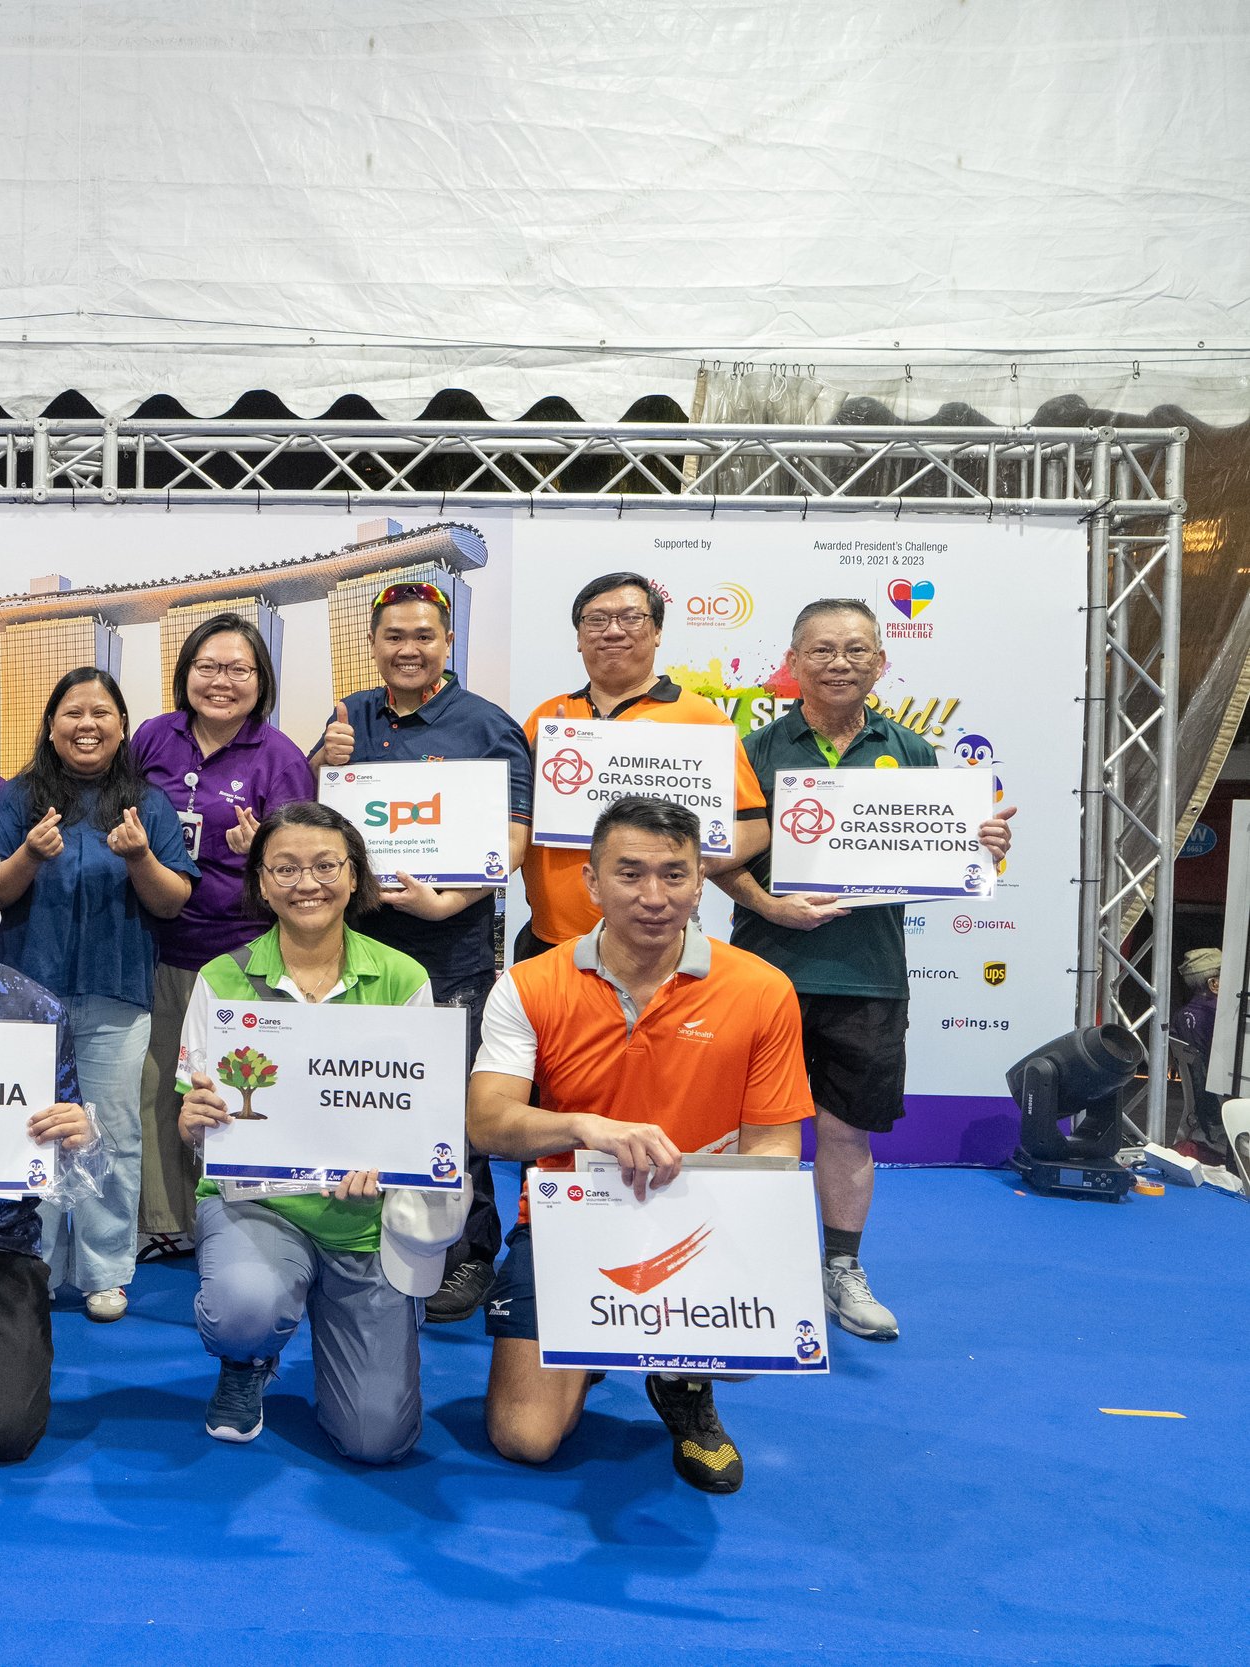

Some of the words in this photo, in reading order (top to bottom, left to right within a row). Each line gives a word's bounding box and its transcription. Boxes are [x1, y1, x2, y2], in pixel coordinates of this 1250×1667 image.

[654, 539, 699, 549] Supported
[702, 539, 711, 550] by
[814, 541, 852, 551] Awarded
[854, 541, 902, 552] President's
[905, 542, 947, 553] Challenge
[840, 556, 864, 566] 2019,
[867, 555, 889, 565] 2021
[892, 556, 900, 565] &
[902, 556, 924, 566] 2023
[886, 622, 934, 630] PRESIDENT'S
[886, 630, 933, 638] CHALLENGE
[750, 698, 796, 731] SE
[608, 756, 702, 771] ADMIRALTY
[598, 772, 711, 789] GRASSROOTS
[364, 792, 440, 834] spd
[853, 804, 954, 816] CANBERRA
[841, 821, 966, 834] GRASSROOTS
[829, 838, 979, 852] ORGANISATIONS
[843, 885, 849, 893] To
[896, 887, 908, 895] Care
[985, 968, 1004, 982] ups
[678, 1027, 714, 1038] SingHealth
[309, 1058, 425, 1079] KAMPUNG
[320, 1090, 411, 1110] SENANG
[590, 1295, 775, 1335] SingHealth
[637, 1355, 647, 1366] To
[648, 1357, 665, 1367] Serve
[666, 1357, 680, 1367] with
[681, 1357, 696, 1368] Love
[696, 1358, 709, 1368] and
[711, 1358, 726, 1369] Care
